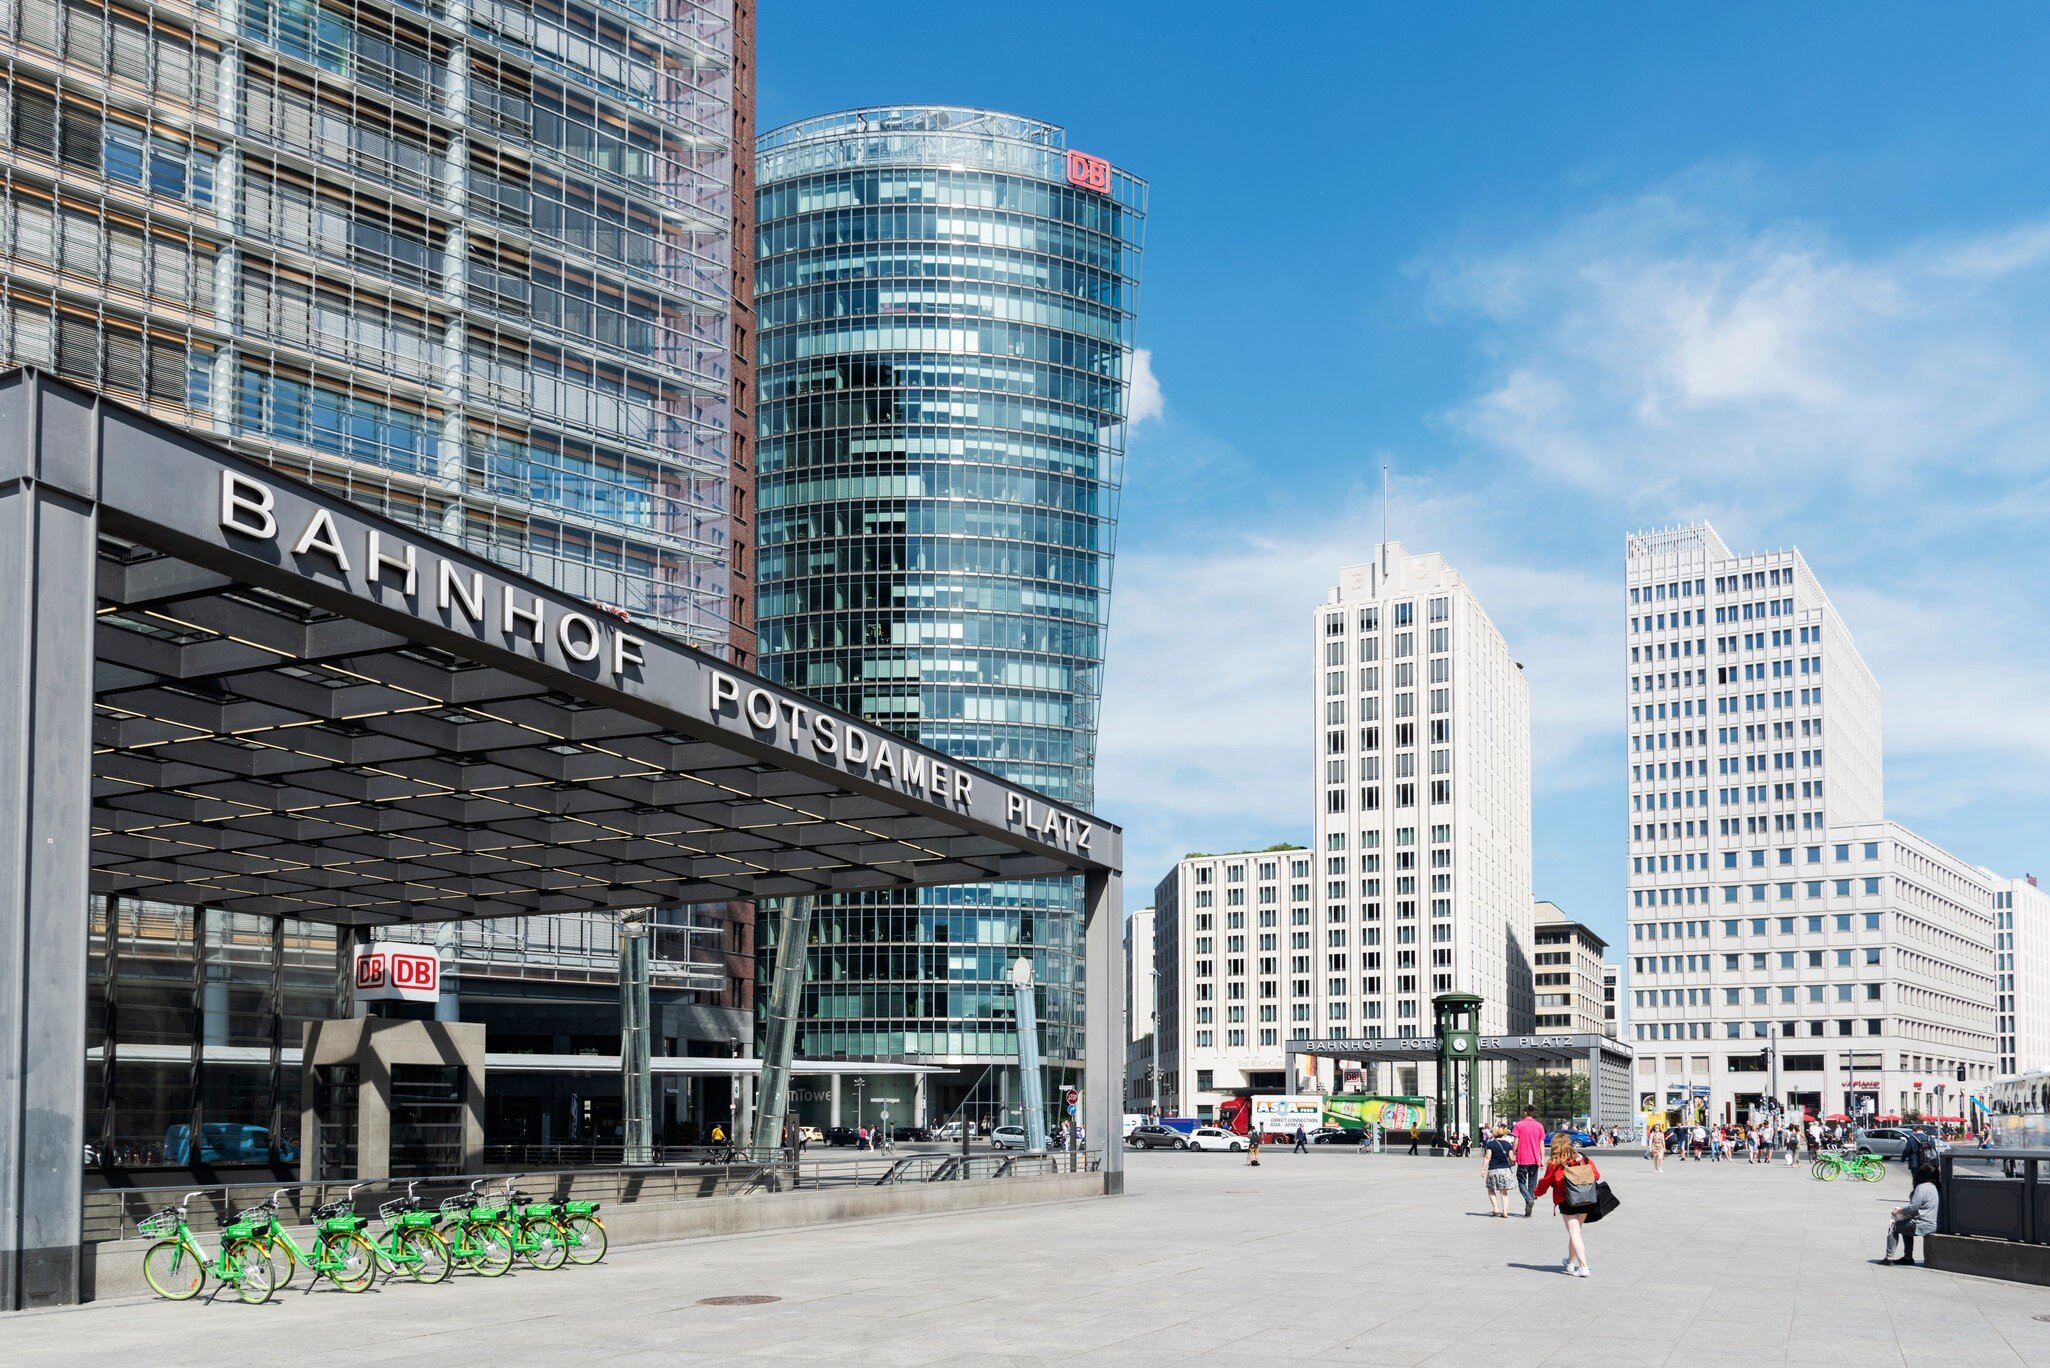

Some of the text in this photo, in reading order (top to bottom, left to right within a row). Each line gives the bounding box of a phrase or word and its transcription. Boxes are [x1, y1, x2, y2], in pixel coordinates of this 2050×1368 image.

[1072, 156, 1106, 188] DB
[219, 469, 1093, 851] BAHNHOF POTSDAMER PLATZ
[360, 959, 382, 984] DB
[397, 959, 431, 985] DB
[1306, 1041, 1383, 1051] BAHNHOF
[1519, 1037, 1574, 1048] PLATZ
